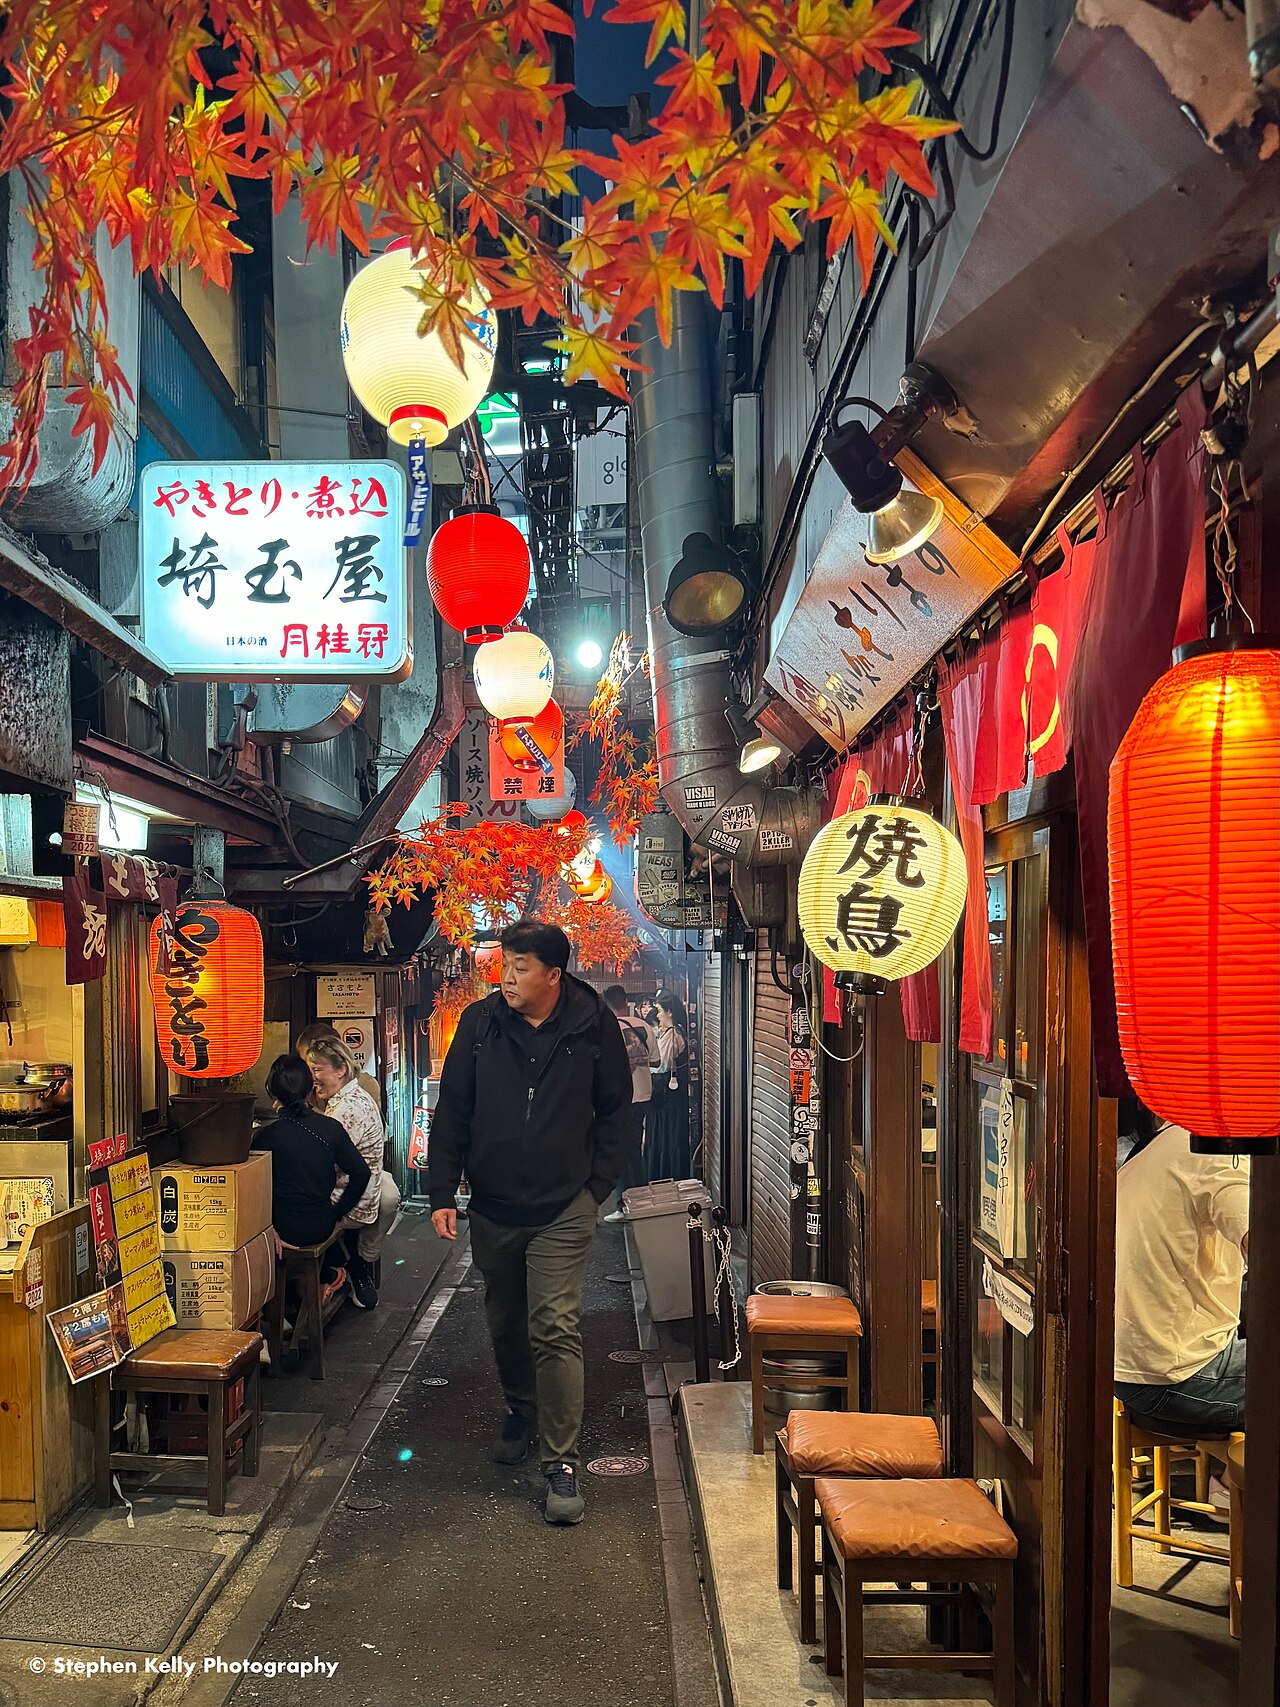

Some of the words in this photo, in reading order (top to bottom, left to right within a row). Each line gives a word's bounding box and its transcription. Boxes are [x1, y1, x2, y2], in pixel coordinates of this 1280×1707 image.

[152, 475, 389, 519] やきとり・煮込
[406, 455, 430, 536] アサヒビール
[156, 531, 388, 610] 埼玉屋
[226, 636, 268, 646] 日本の酒
[279, 623, 389, 659] 月桂冠
[465, 718, 484, 818] ソース焼ソバ
[503, 776, 555, 795] 禁煙
[685, 786, 715, 800] VISAH
[71, 842, 96, 853] 2022
[711, 829, 741, 849] VISAH
[762, 836, 790, 846] 2KILER
[825, 814, 928, 959] 焼鳥
[157, 909, 220, 1072] やきとり
[327, 984, 364, 992] ささもと
[162, 1186, 177, 1224] 白炭
[28, 1288, 42, 1305] 2022
